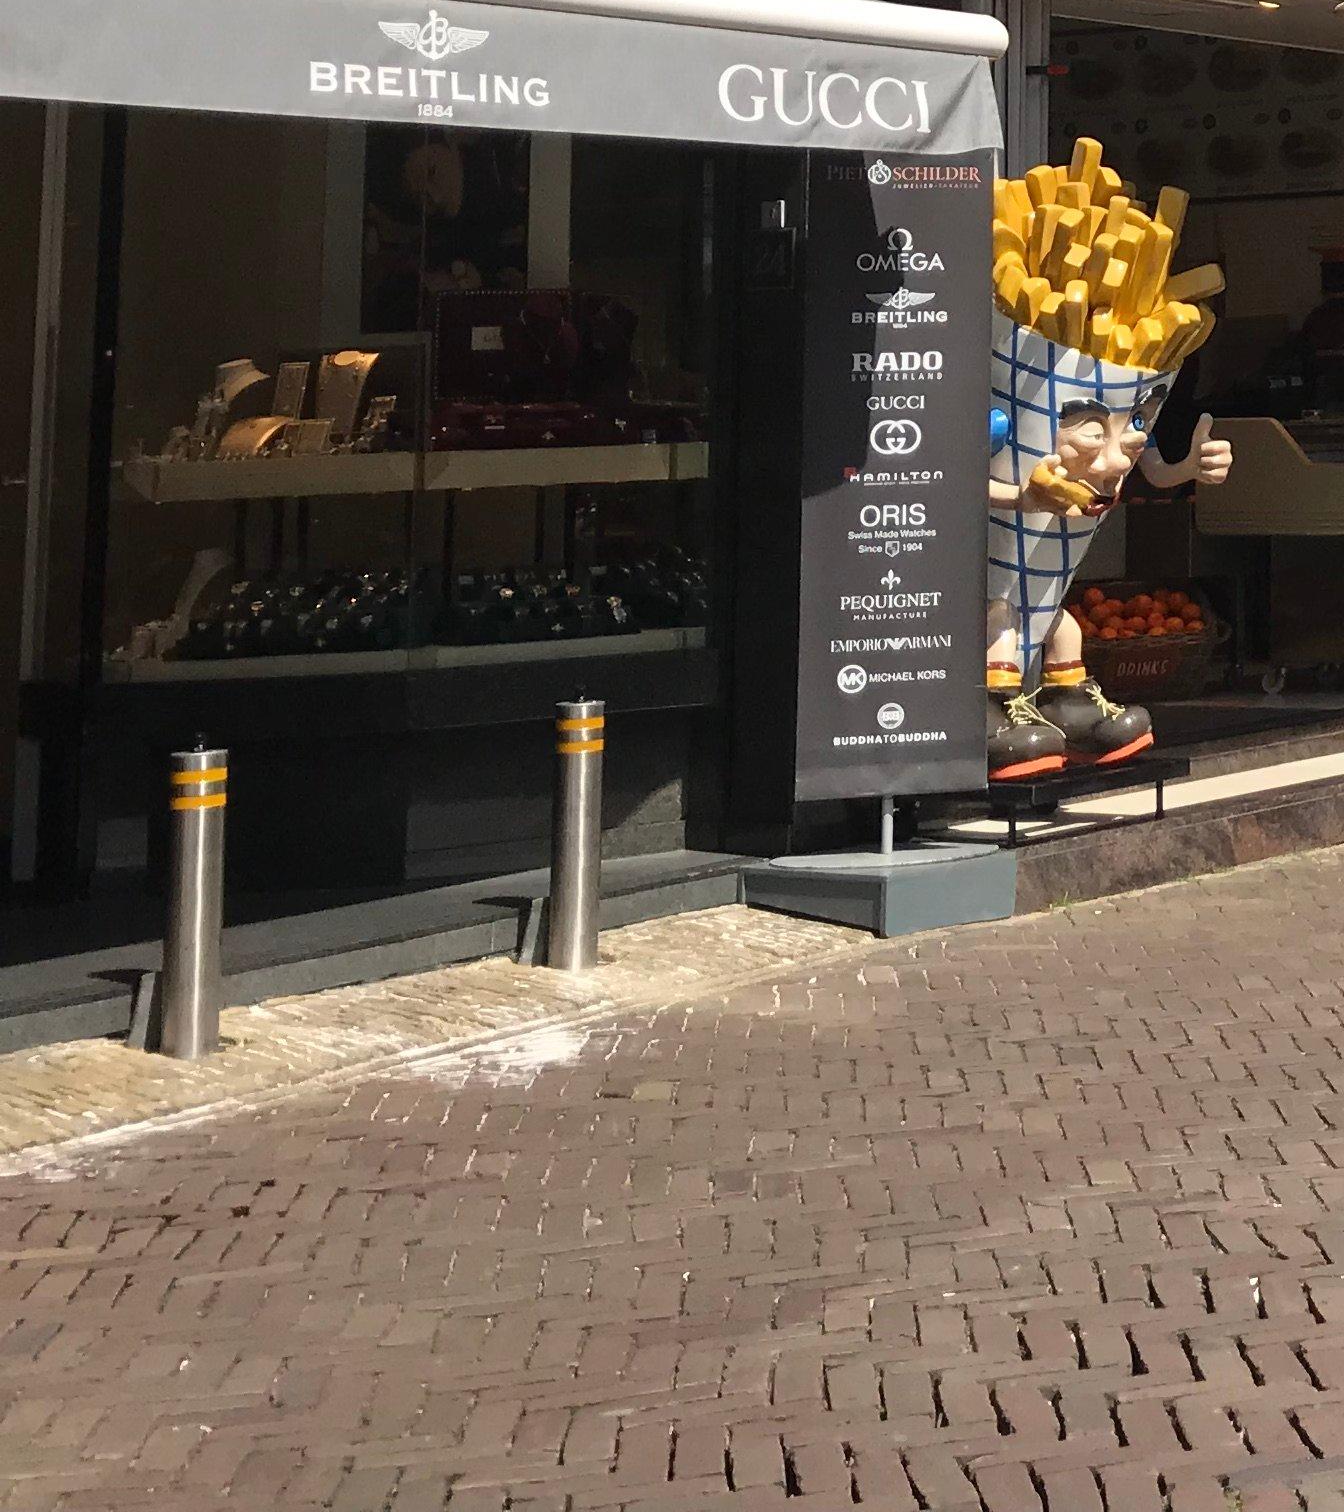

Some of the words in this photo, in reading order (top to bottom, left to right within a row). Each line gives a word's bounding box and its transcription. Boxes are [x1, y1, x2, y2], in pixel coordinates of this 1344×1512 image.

[309, 60, 550, 108] BREITLING
[717, 63, 930, 134] GUCCI
[417, 102, 453, 119] 1884
[892, 166, 982, 183] SCHILDER
[856, 253, 945, 272] OMEGA
[852, 310, 948, 324] BREITLING
[852, 351, 943, 372] RADO
[851, 372, 943, 382] SWITZERLAND
[866, 395, 925, 411] GUCCI
[850, 470, 943, 483] HAMILTON
[860, 503, 926, 527] ORIS
[848, 531, 873, 540] Swiss
[874, 530, 899, 539] Made
[900, 528, 937, 538] Watches
[858, 544, 883, 553] Since
[902, 542, 923, 551] 1904
[840, 592, 942, 614] PEQUIGNET
[853, 611, 927, 620] MANUFACTURE
[830, 637, 887, 653] EMPORIO
[903, 634, 952, 650] ARMANI
[869, 672, 914, 683] MICHAEL
[917, 670, 946, 681] KORS
